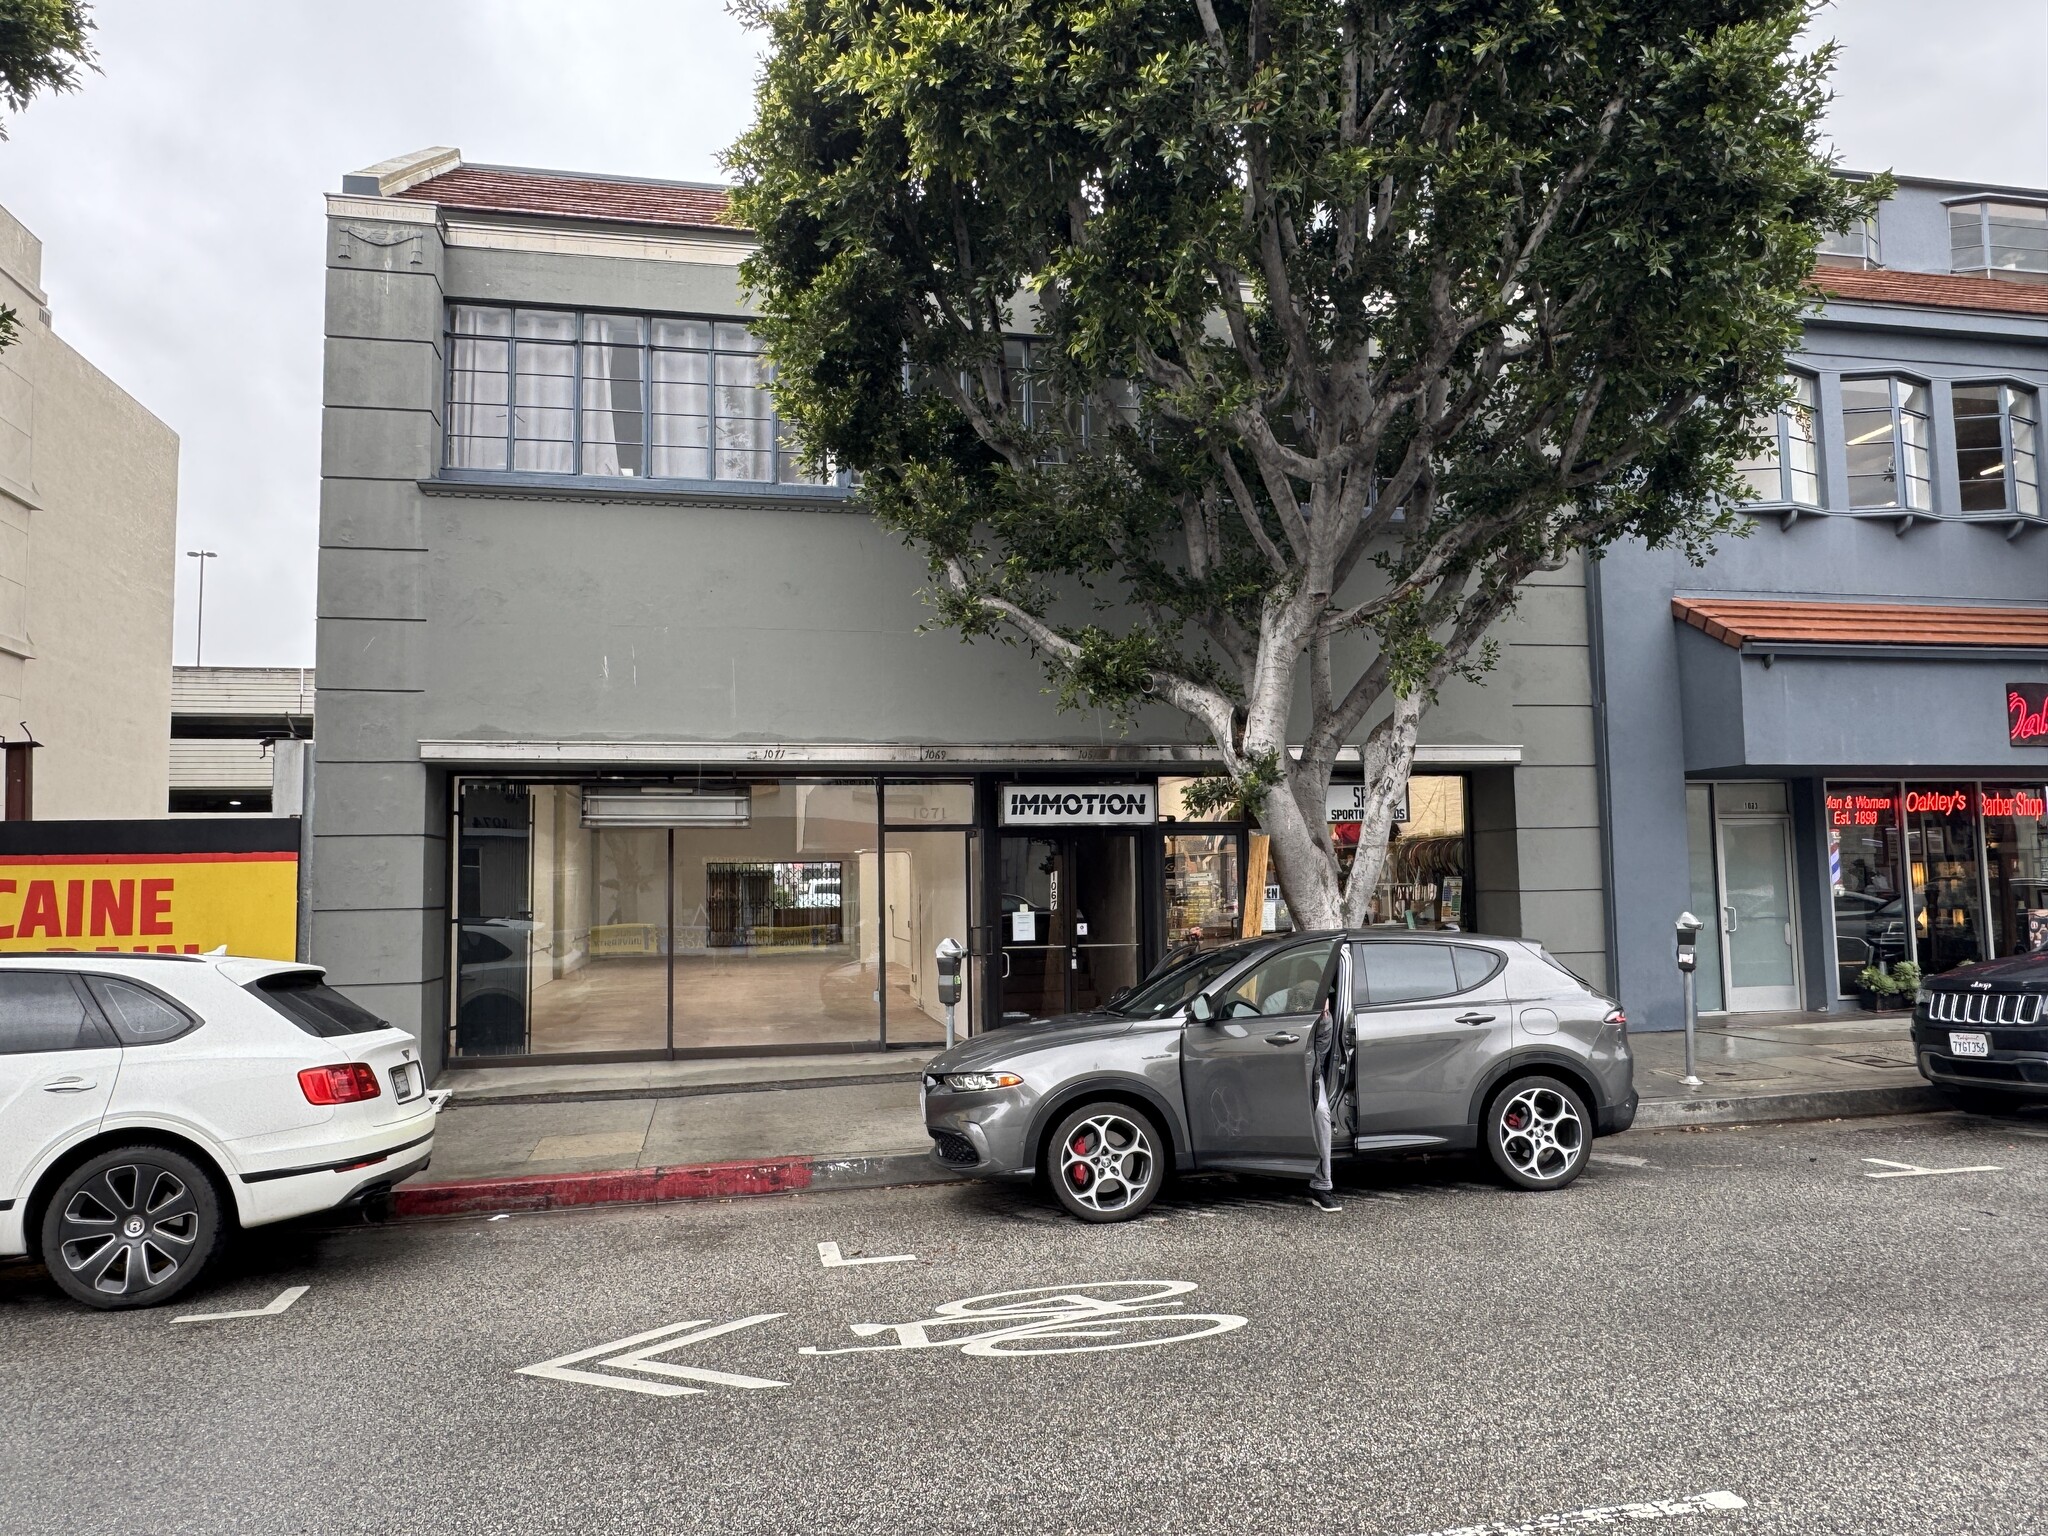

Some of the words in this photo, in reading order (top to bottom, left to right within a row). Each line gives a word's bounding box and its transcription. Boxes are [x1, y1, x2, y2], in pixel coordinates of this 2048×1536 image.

[763, 749, 786, 760] 1071
[924, 749, 947, 760] 1069
[1011, 794, 1146, 815] IMMOTION
[1844, 795, 1853, 809] &
[1855, 795, 1891, 809] Women
[1906, 790, 1967, 816] Oakley's
[1981, 792, 2015, 816] Barber
[2015, 791, 2043, 821] Shop
[913, 807, 947, 820] 1071
[1331, 809, 1365, 820] SPORTI
[1854, 811, 1878, 825] 1898
[1050, 872, 1058, 910] 1067
[1264, 888, 1278, 899] EN
